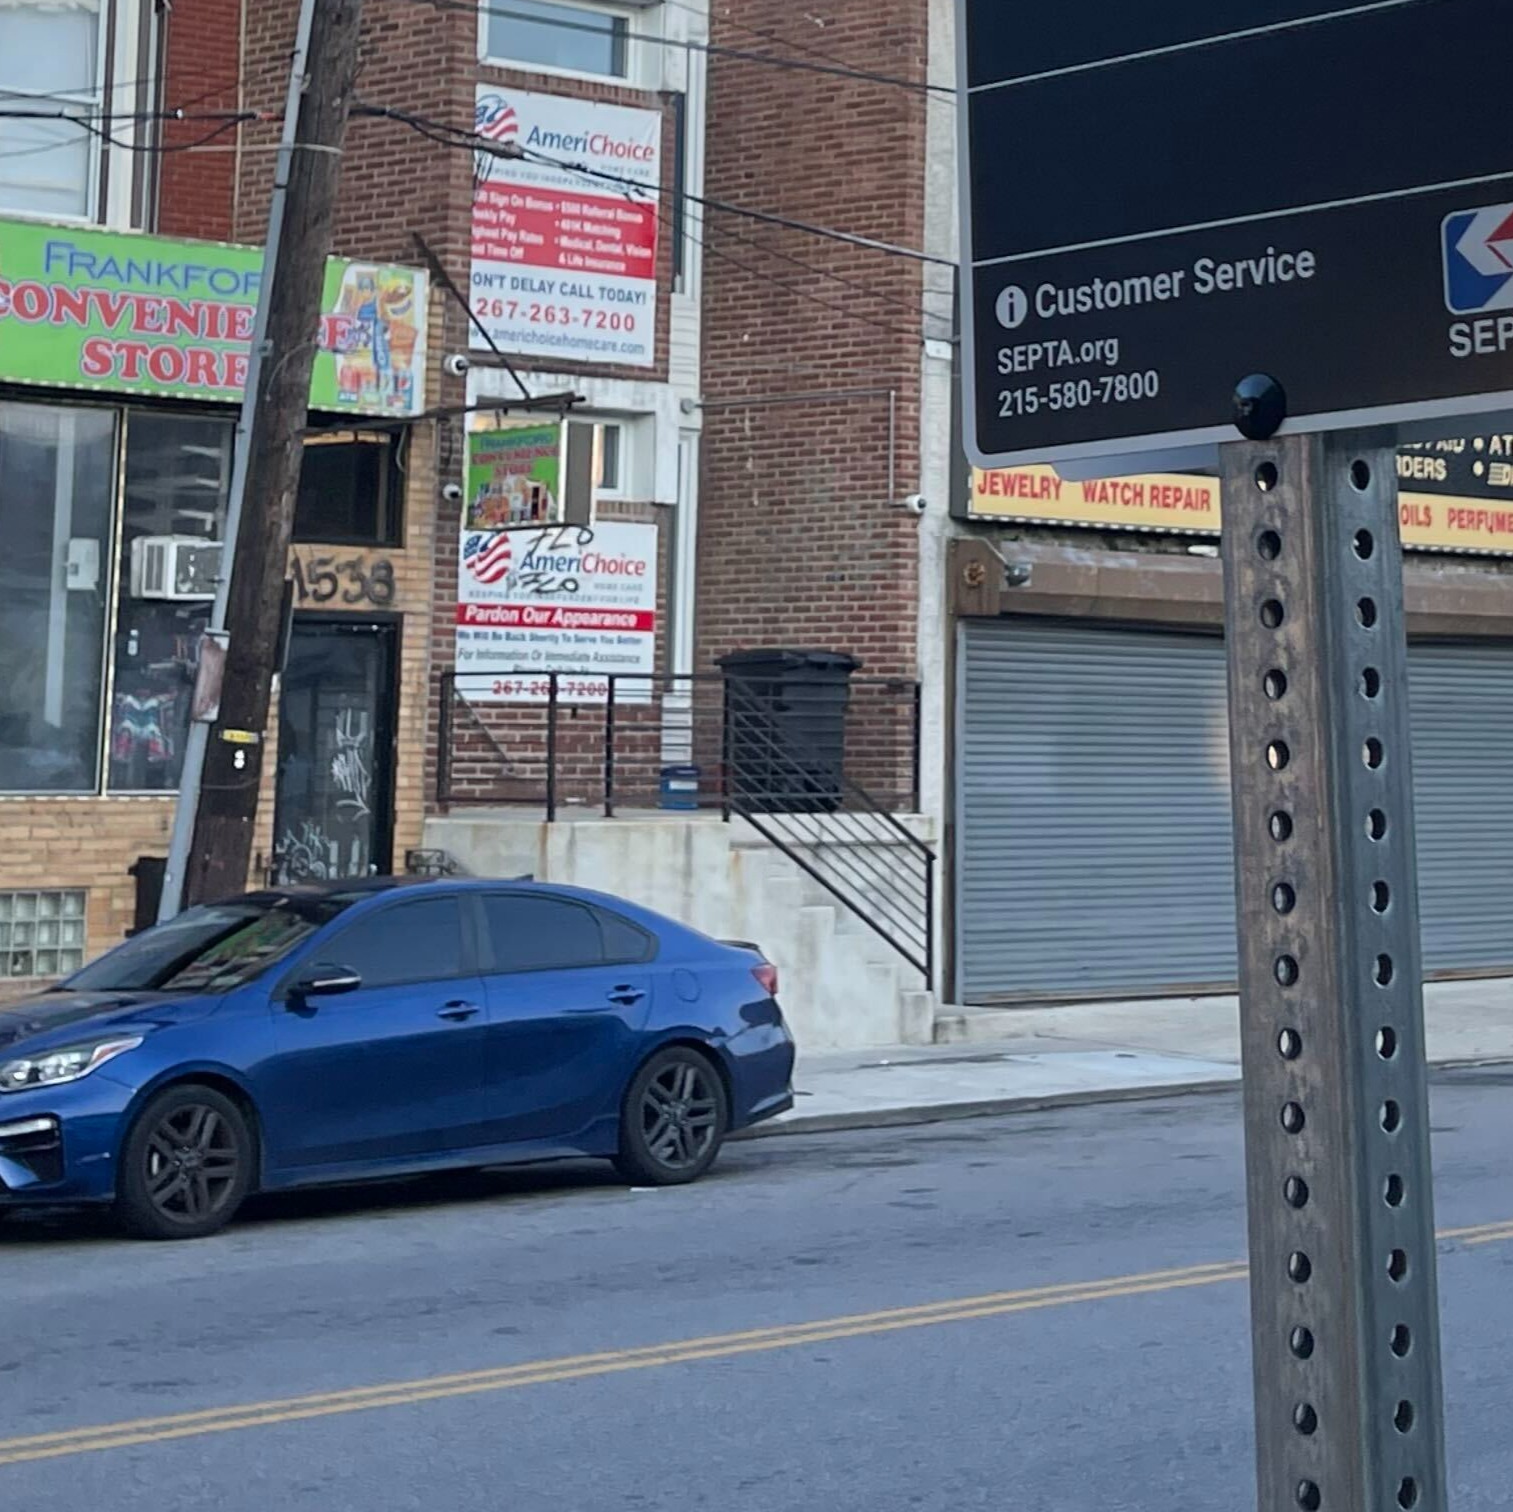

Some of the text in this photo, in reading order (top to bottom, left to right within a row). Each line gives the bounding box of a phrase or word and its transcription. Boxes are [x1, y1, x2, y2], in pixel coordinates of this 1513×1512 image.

[526, 125, 655, 162] AmeriChoice
[44, 241, 264, 295] FRANKFOR
[1035, 247, 1316, 320] Customer Service
[473, 271, 647, 305] ON'T DELAY CALL TODAY!
[476, 297, 636, 333] 267-263-7200
[82, 338, 249, 388] STORE
[997, 336, 1120, 375] SEPTA.org
[997, 370, 1160, 419] 215-580-7800
[978, 471, 1062, 501] JEWELRY
[1082, 479, 1144, 507] WATCH
[1150, 485, 1211, 512] REPAIR
[1401, 504, 1432, 527] OILS
[519, 550, 646, 577] AmeriChoice
[465, 605, 638, 628] Pardon Our Appearance
[492, 680, 608, 697] 267-26-7200
